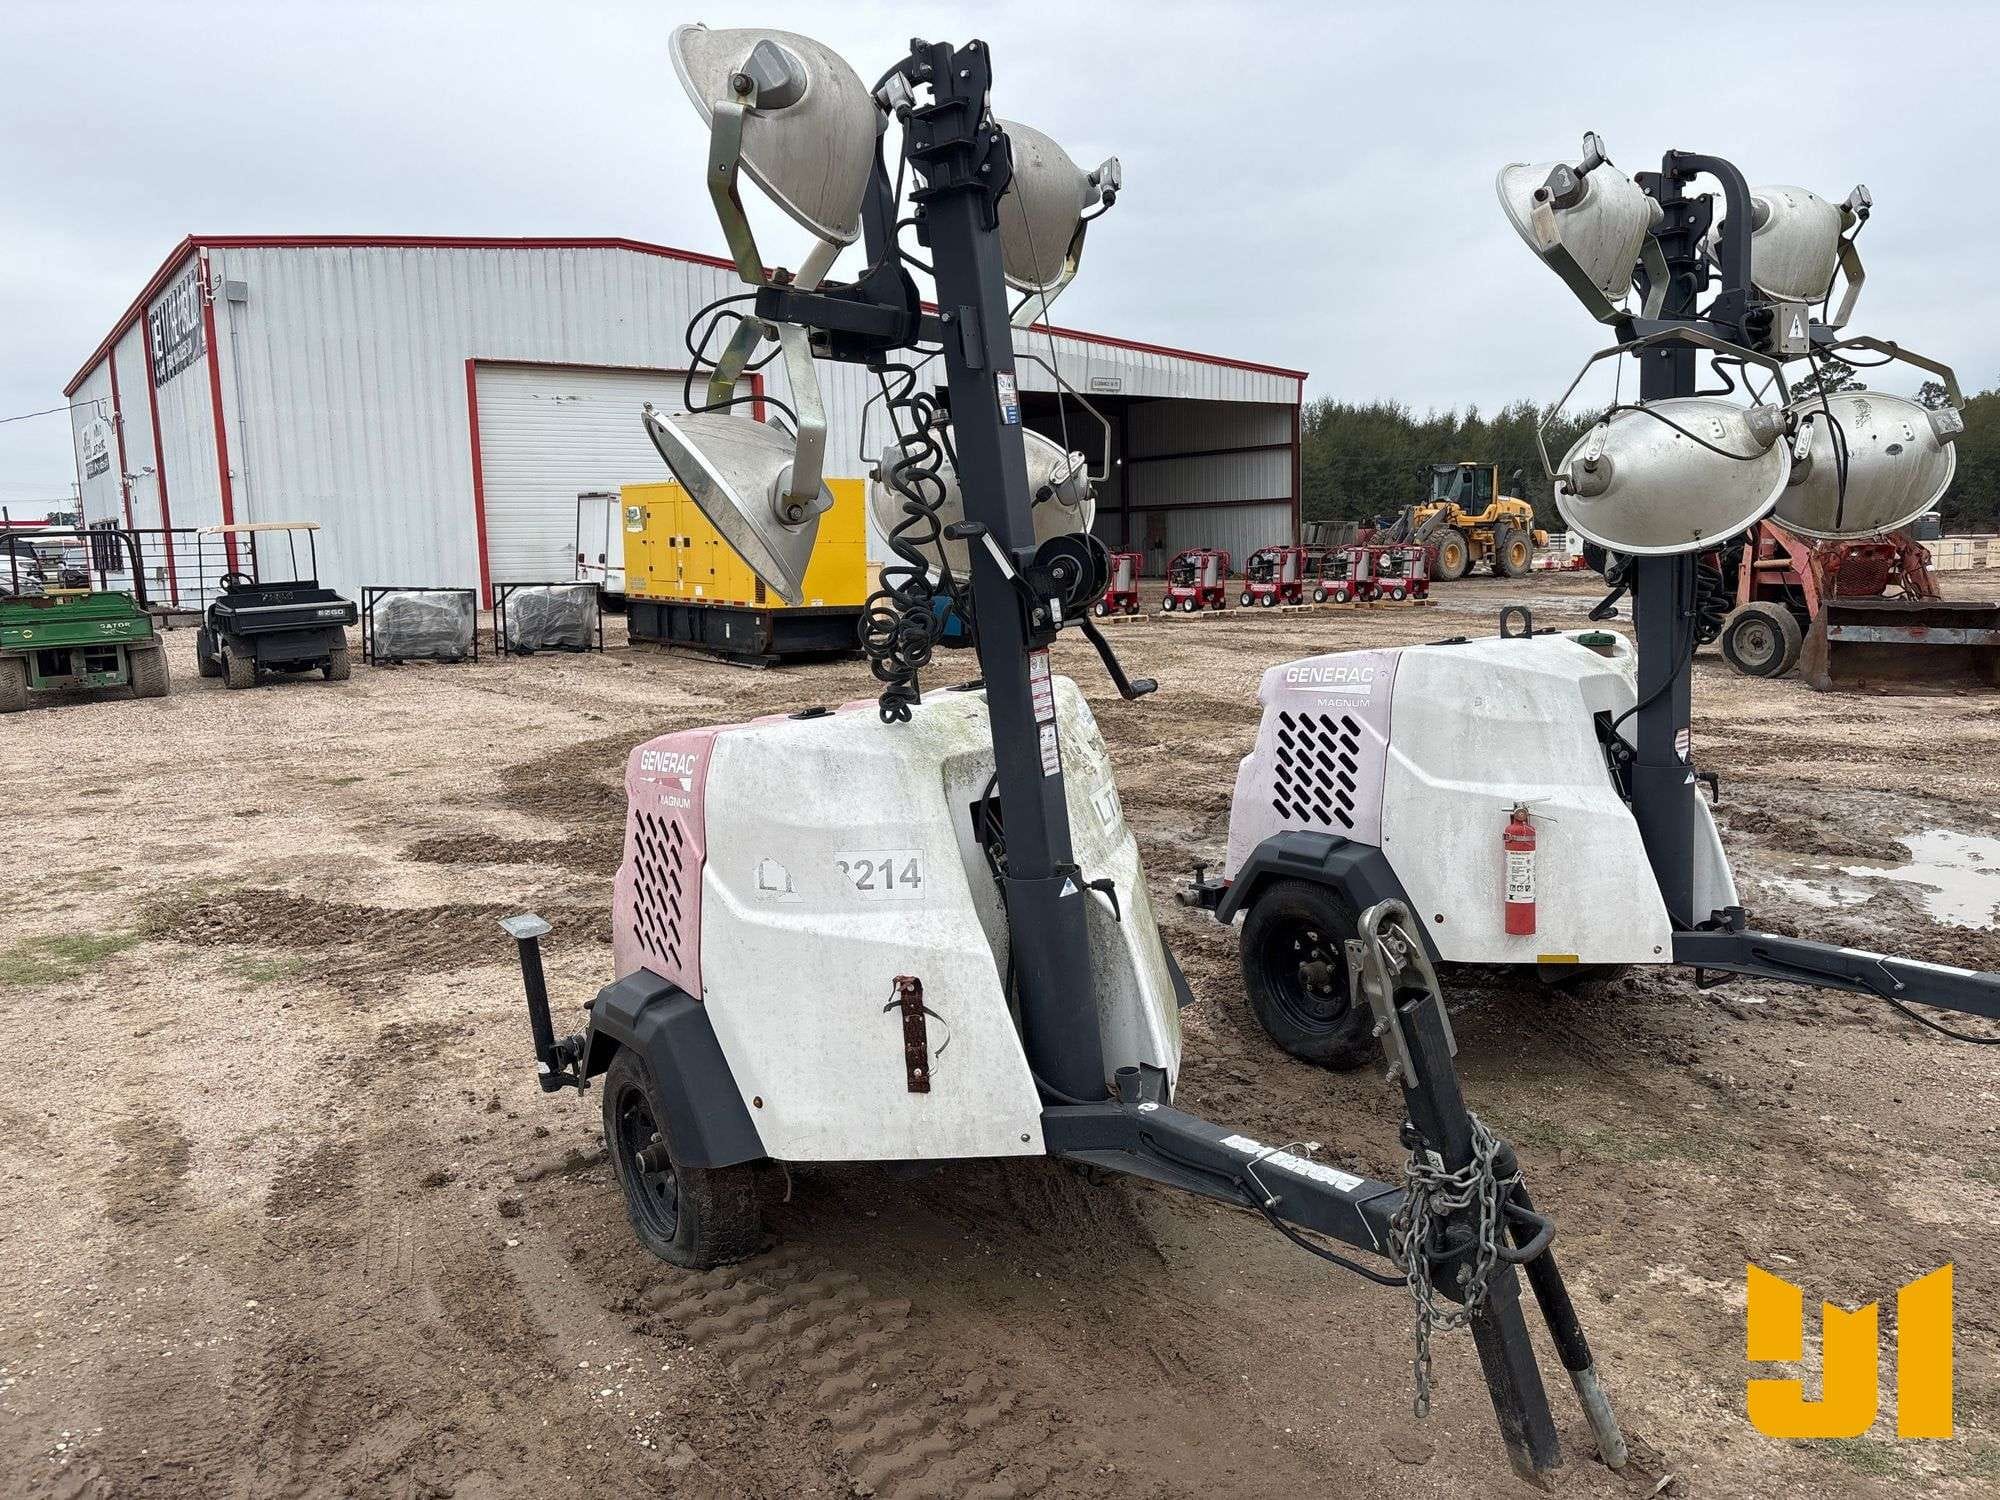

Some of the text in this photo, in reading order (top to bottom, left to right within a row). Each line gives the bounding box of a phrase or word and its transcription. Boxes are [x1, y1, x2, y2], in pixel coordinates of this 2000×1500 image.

[99, 621, 132, 629] GATOR
[1286, 667, 1374, 683] GENERAC
[1317, 698, 1370, 707] MAGNUM
[640, 749, 696, 776] GENERAC
